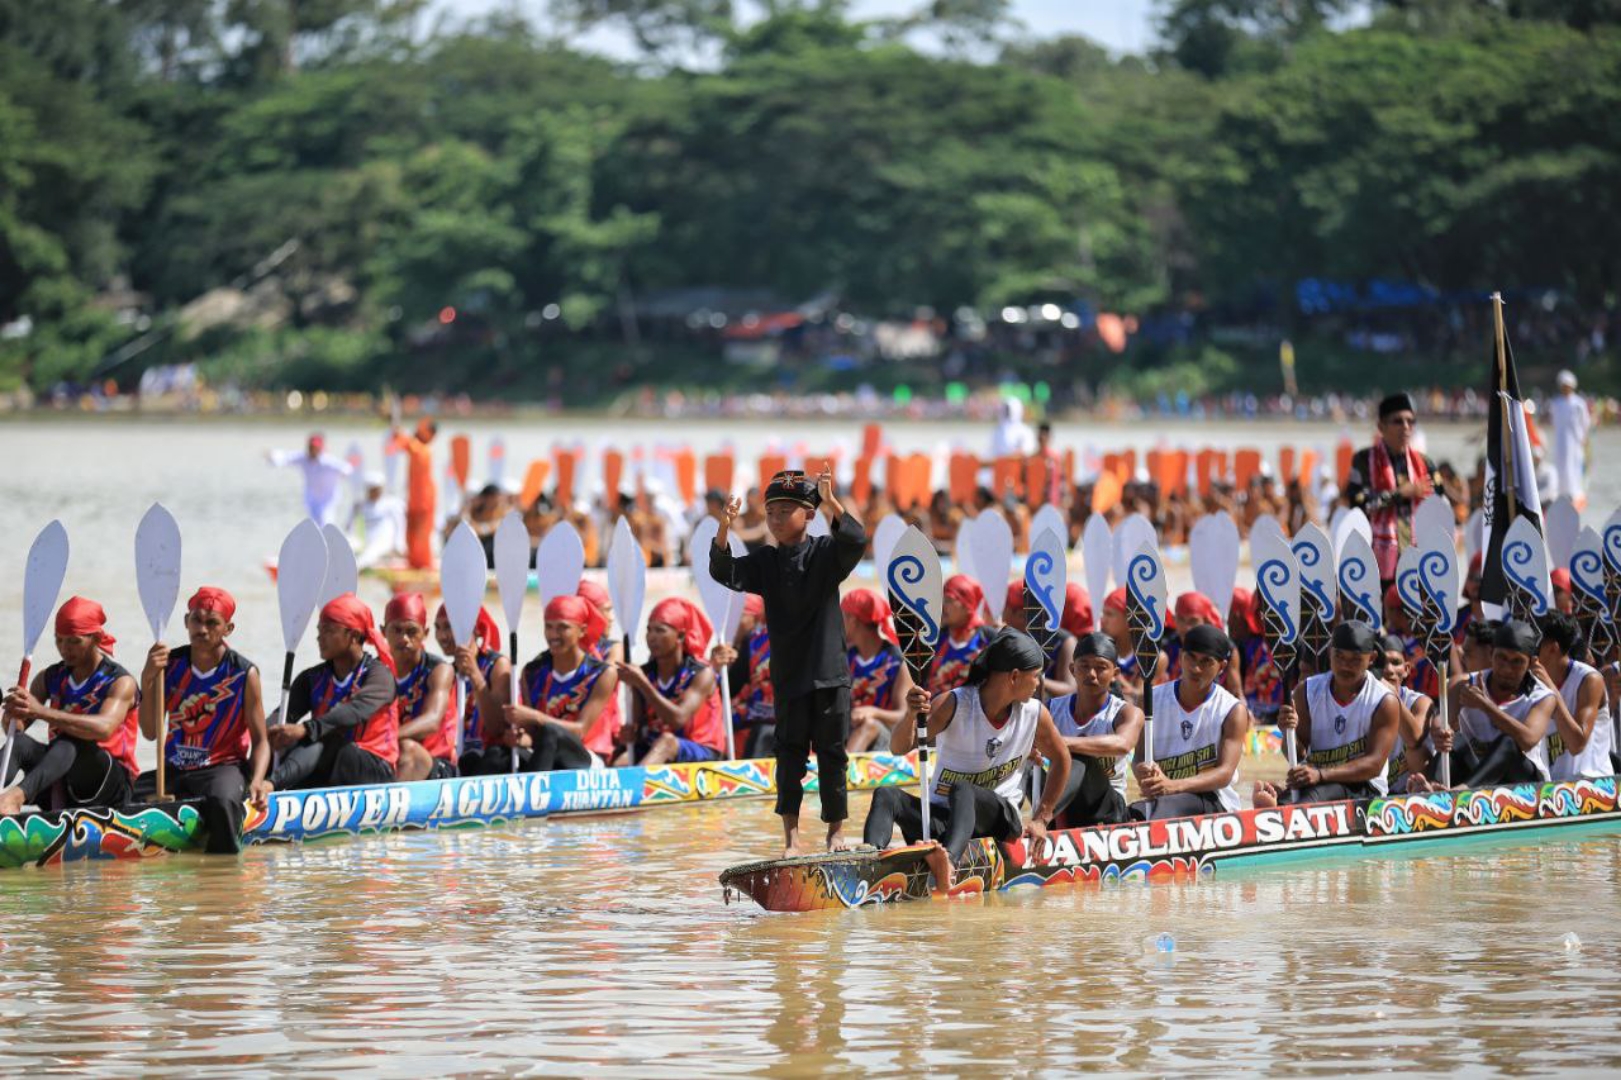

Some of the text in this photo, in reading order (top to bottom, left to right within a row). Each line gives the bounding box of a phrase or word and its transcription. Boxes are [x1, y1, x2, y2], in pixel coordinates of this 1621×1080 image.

[269, 773, 551, 834] POWER AGUNG
[576, 769, 620, 790] DUTA
[1022, 804, 1350, 869] PANGLIMO SATI
